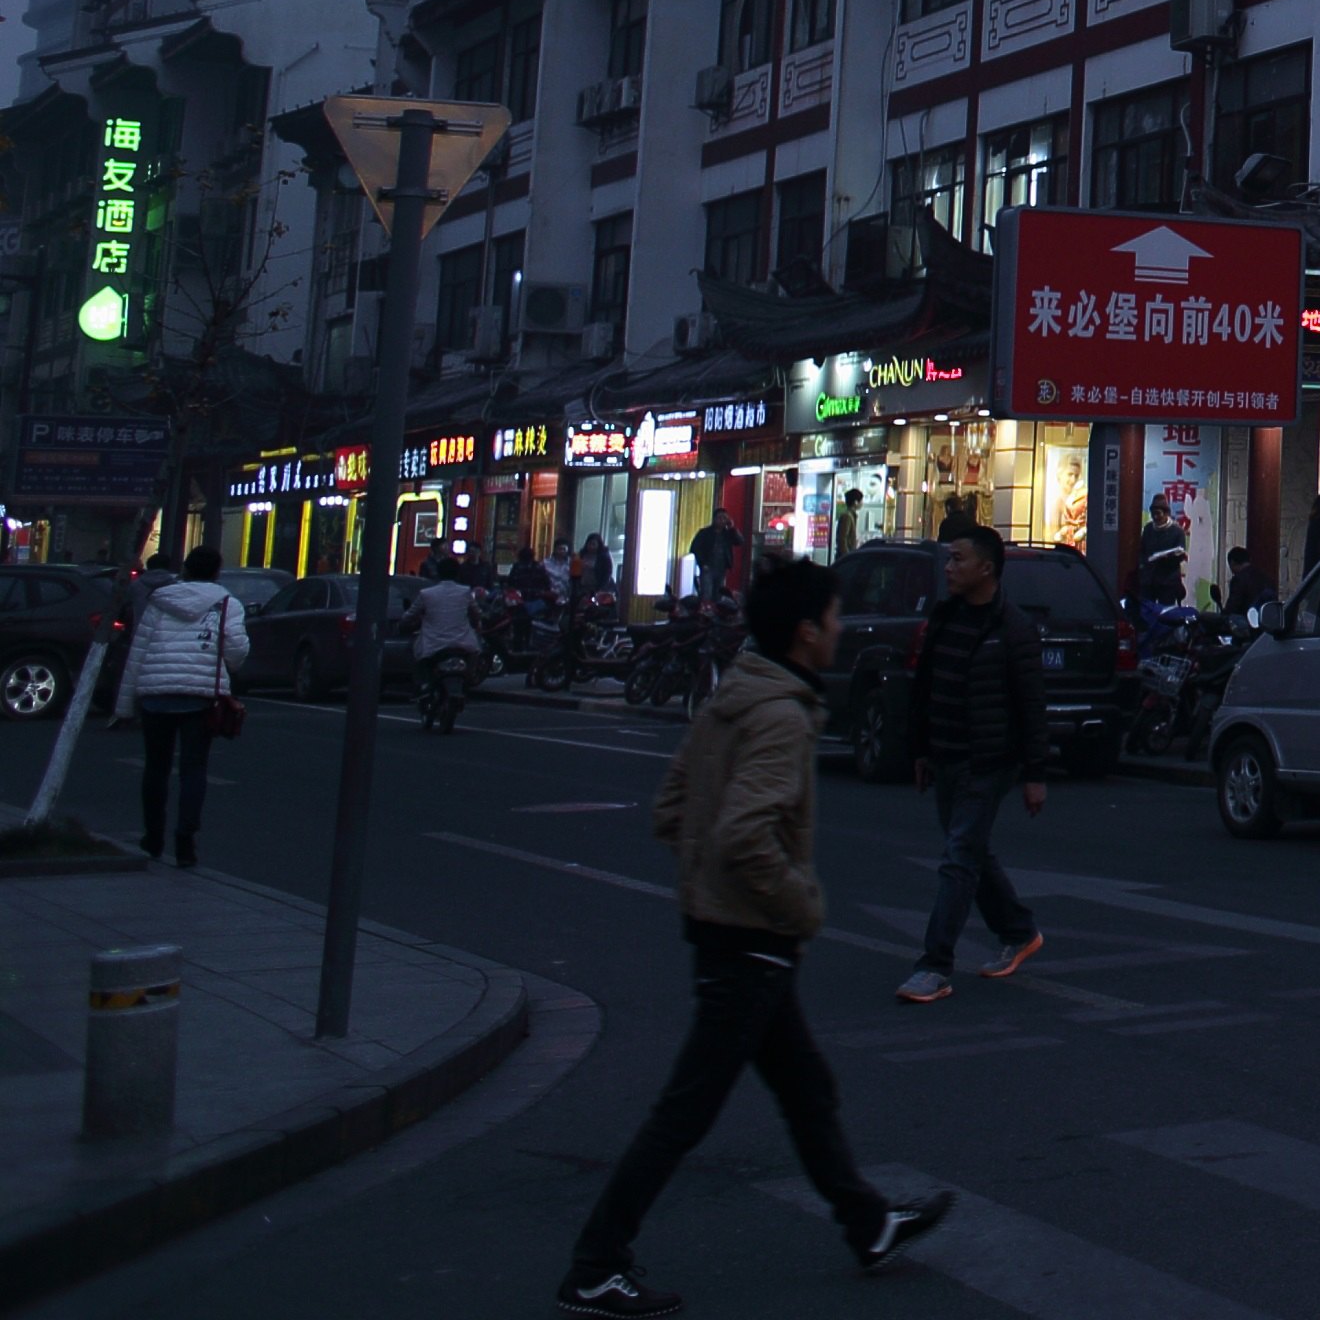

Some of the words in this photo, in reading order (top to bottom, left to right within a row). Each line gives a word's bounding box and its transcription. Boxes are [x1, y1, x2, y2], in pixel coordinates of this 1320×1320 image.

[92, 118, 142, 274] 海友酒店
[1027, 284, 1285, 349] 来必堡向前40米
[869, 355, 924, 388] CHANUN
[31, 424, 50, 443] P
[514, 424, 548, 458] 麻辣烫
[1106, 449, 1119, 467] P
